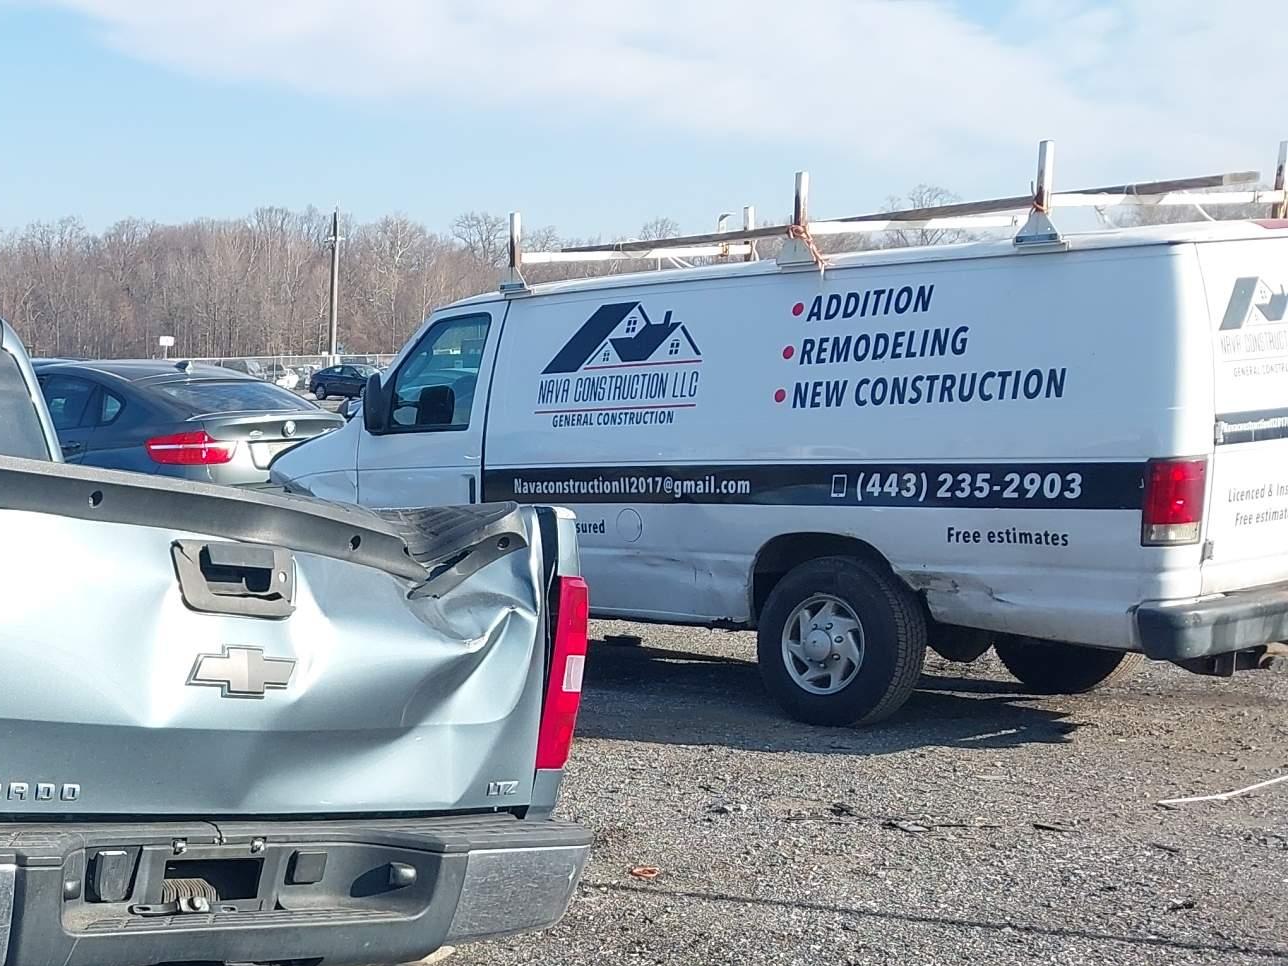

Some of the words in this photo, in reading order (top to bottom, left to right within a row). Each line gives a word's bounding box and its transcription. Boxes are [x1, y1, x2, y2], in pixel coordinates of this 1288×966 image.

[806, 285, 935, 322] ADDITION
[799, 326, 970, 365] REMODELING
[538, 379, 570, 405] NAVA
[574, 373, 669, 402] CONSTRUCTION
[672, 371, 699, 398] LLC
[792, 379, 848, 409] NEW
[855, 368, 1067, 407] CONSTRUCTION
[552, 412, 594, 428] GENERAL
[597, 410, 674, 426] CONSTRUCTION
[856, 472, 928, 502] (443)
[936, 472, 1083, 499] 235-2903
[1235, 512, 1253, 528] Free
[946, 526, 981, 544] Free
[987, 527, 1069, 547] estimates
[486, 780, 519, 797] LTZ
